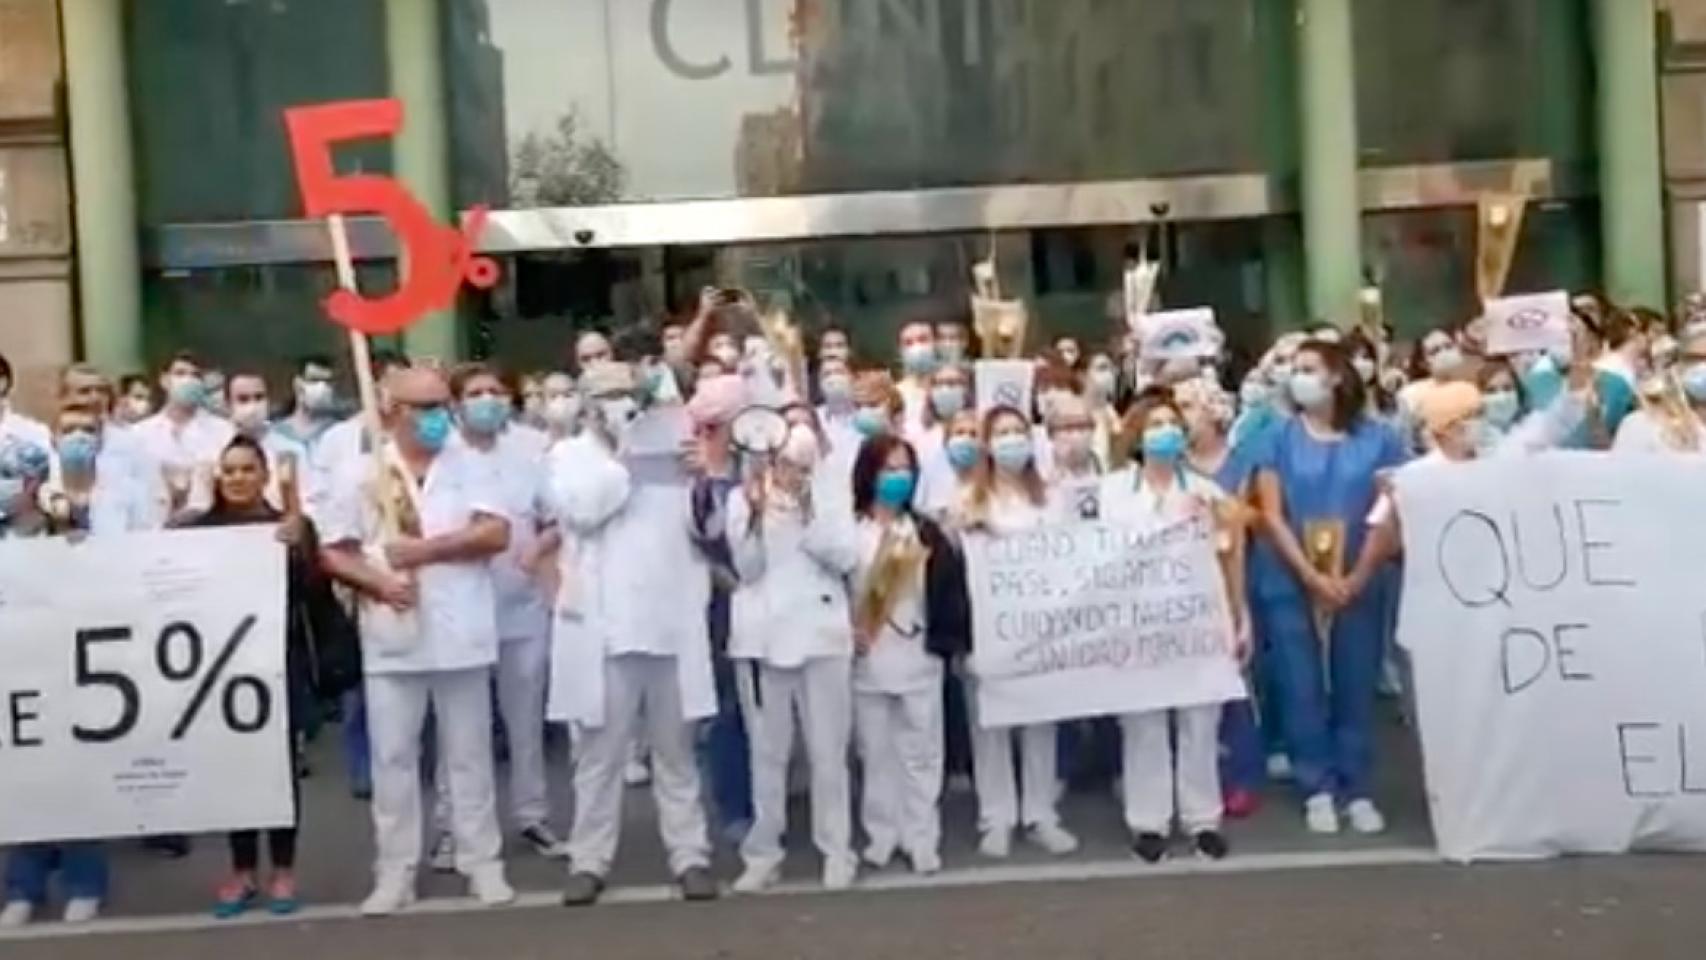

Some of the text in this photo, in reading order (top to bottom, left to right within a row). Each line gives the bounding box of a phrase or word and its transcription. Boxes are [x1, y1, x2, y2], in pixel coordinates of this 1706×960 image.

[1437, 499, 1637, 608] QUE
[0, 612, 272, 746] E 5%
[1500, 623, 1595, 695] DE
[1615, 722, 1706, 797] EL
